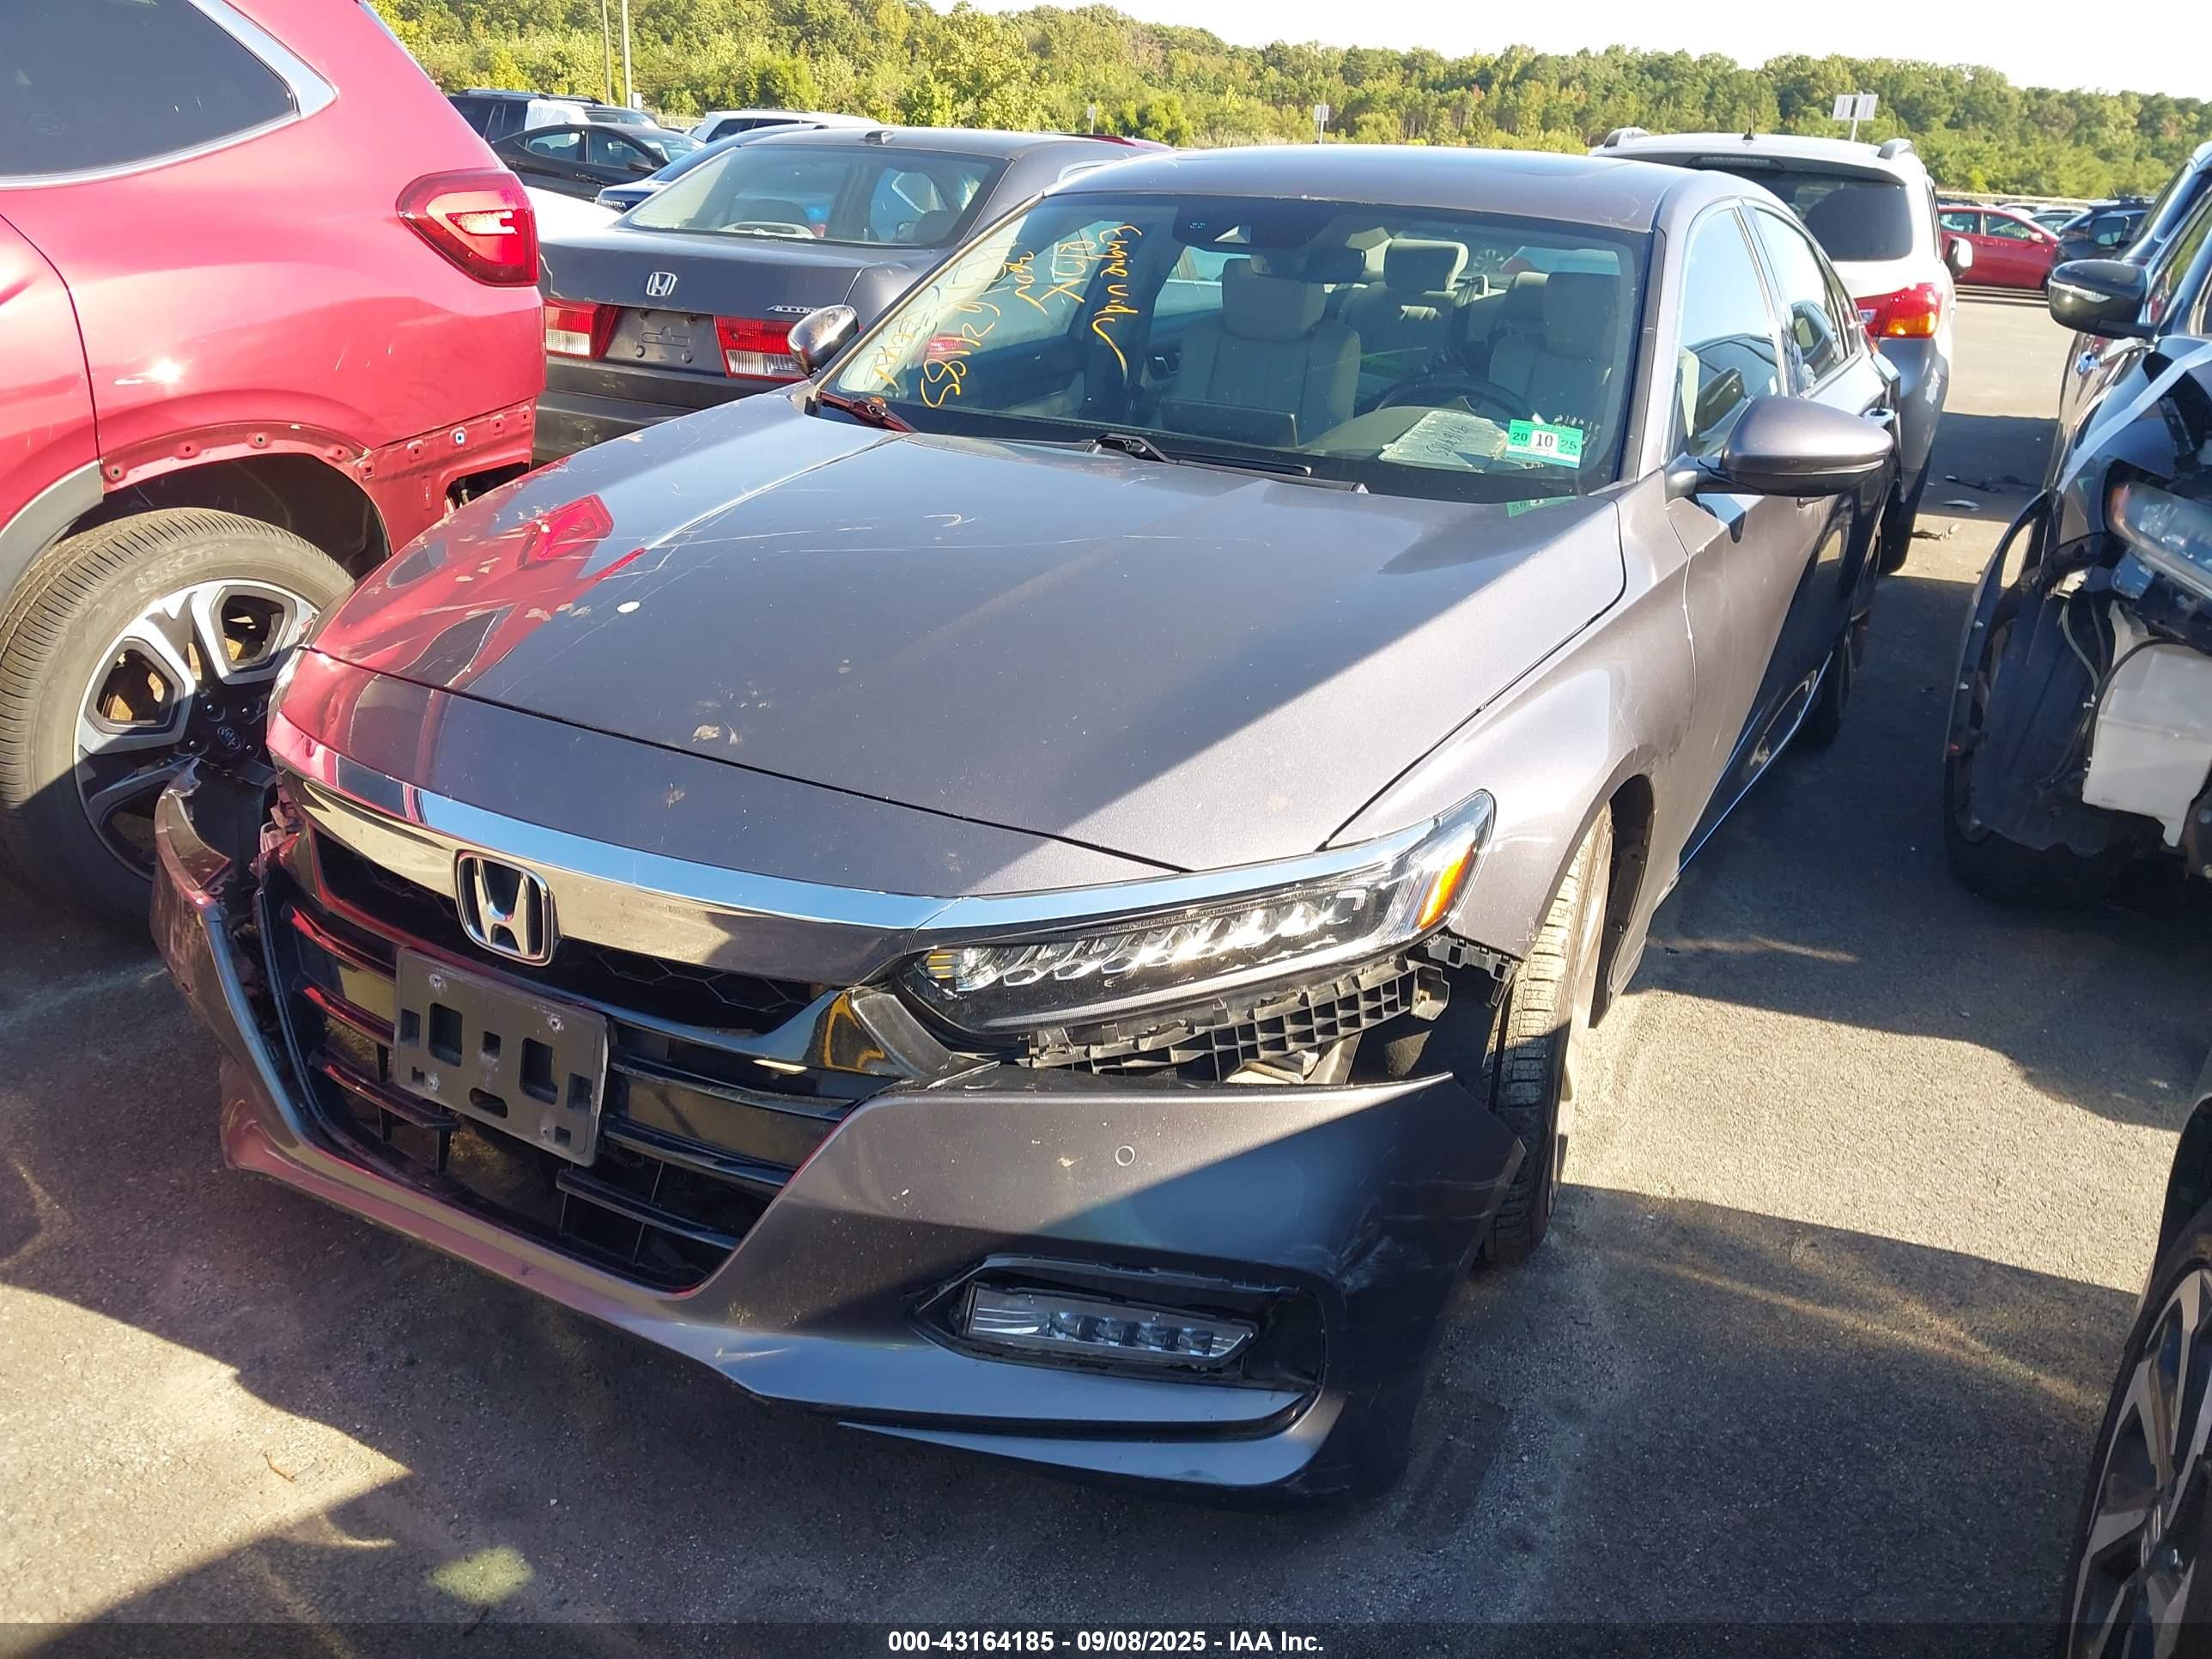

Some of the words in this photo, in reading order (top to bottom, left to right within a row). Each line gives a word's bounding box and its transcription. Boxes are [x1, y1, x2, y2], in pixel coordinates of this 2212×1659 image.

[766, 305, 818, 315] ACCOR
[1513, 432, 1528, 441] 20
[1536, 434, 1553, 447] 10
[1560, 439, 1577, 450] 25
